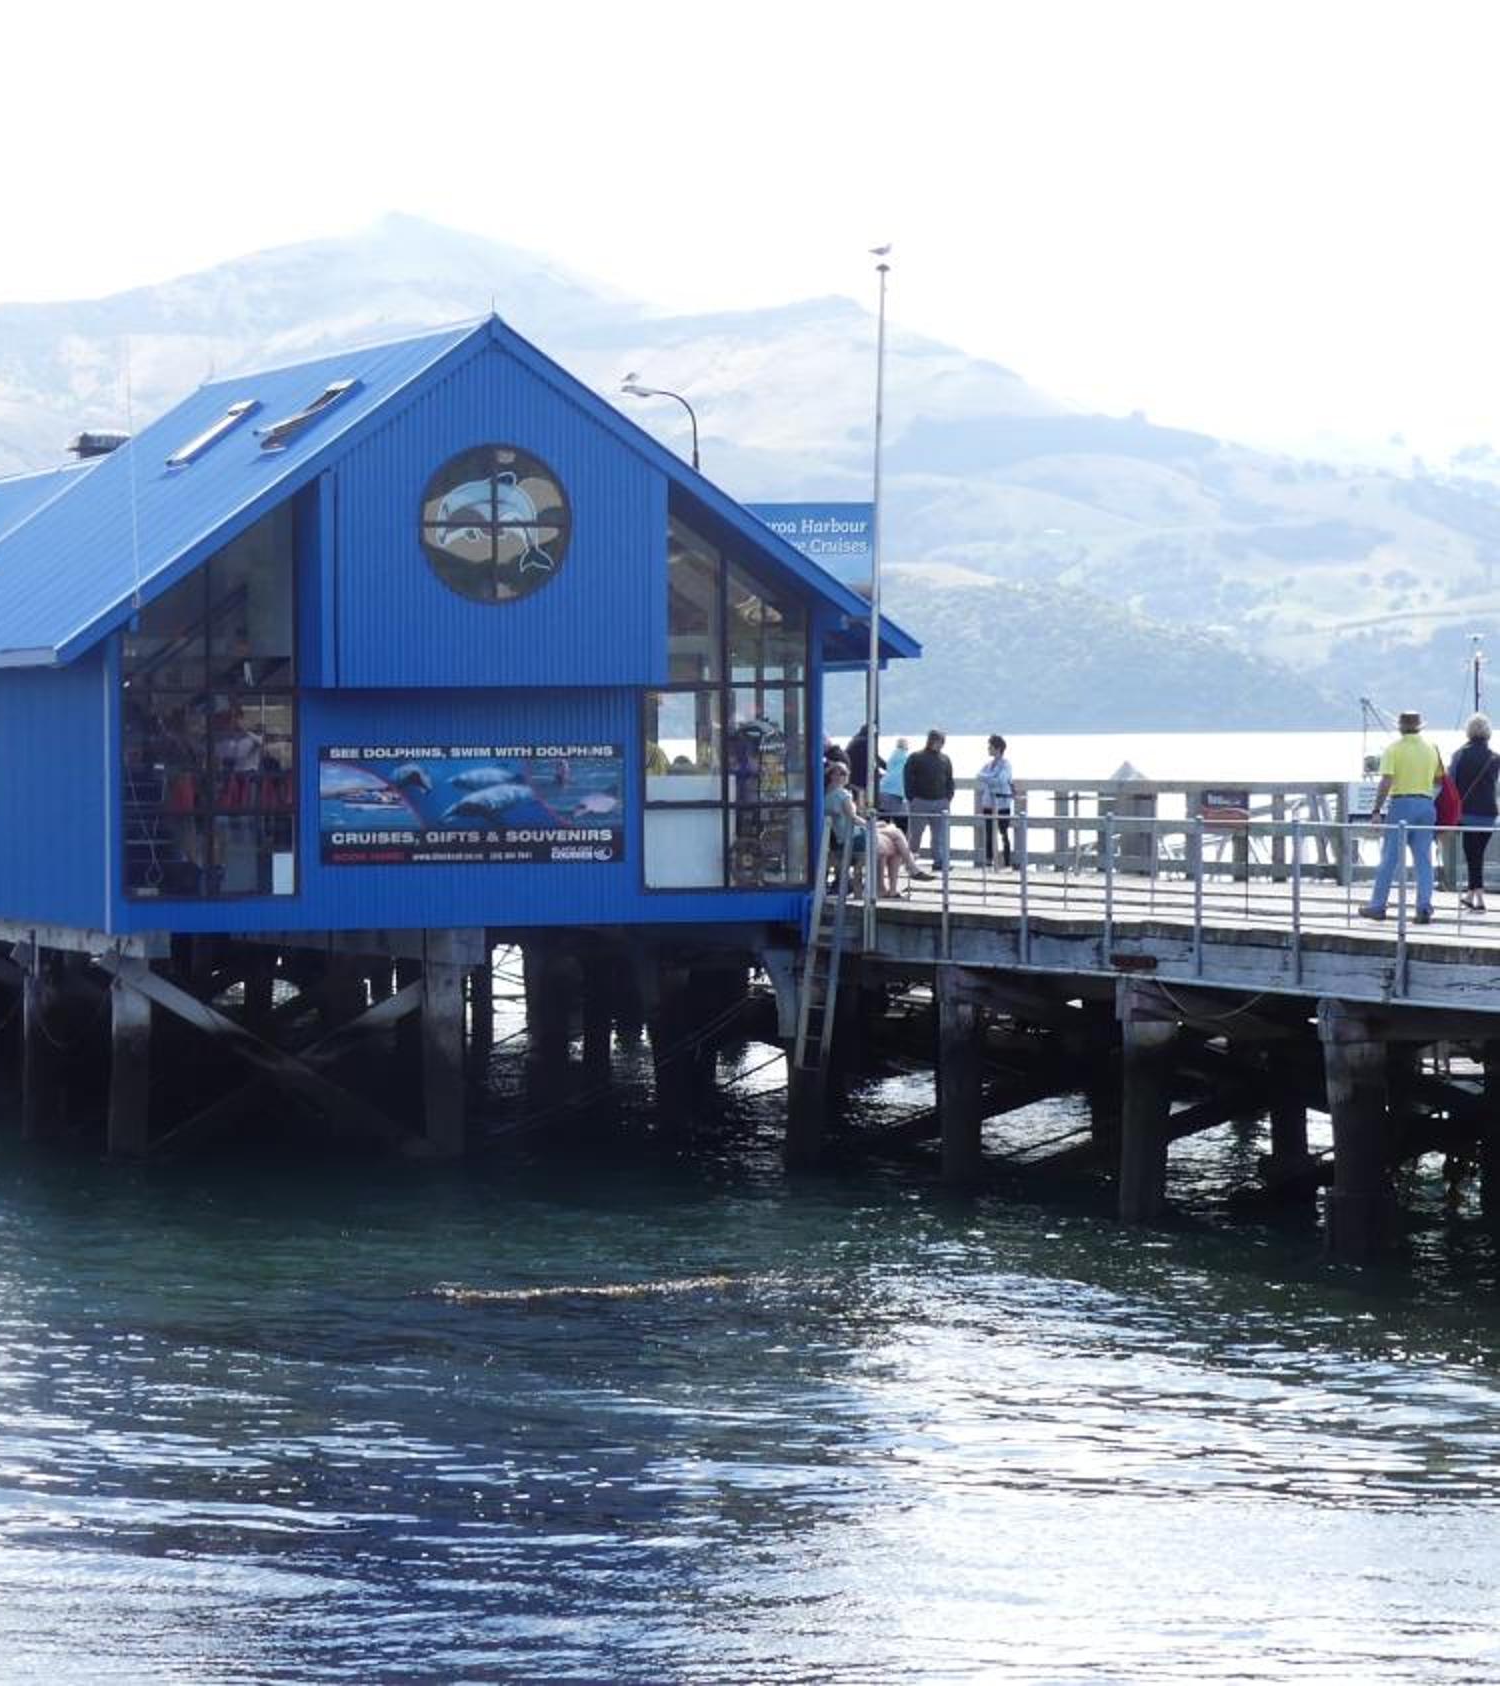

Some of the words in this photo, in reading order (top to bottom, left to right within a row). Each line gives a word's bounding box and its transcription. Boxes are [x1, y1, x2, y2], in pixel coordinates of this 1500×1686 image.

[802, 519, 868, 533] Harbour
[810, 539, 868, 553] Cruises
[363, 747, 447, 759] DOLPHINS,
[450, 747, 491, 758] SWIM
[496, 747, 532, 758] WITH
[331, 831, 420, 845] CRUISES,
[425, 831, 480, 843] GIFTS
[505, 829, 612, 842] SOUVENIRS
